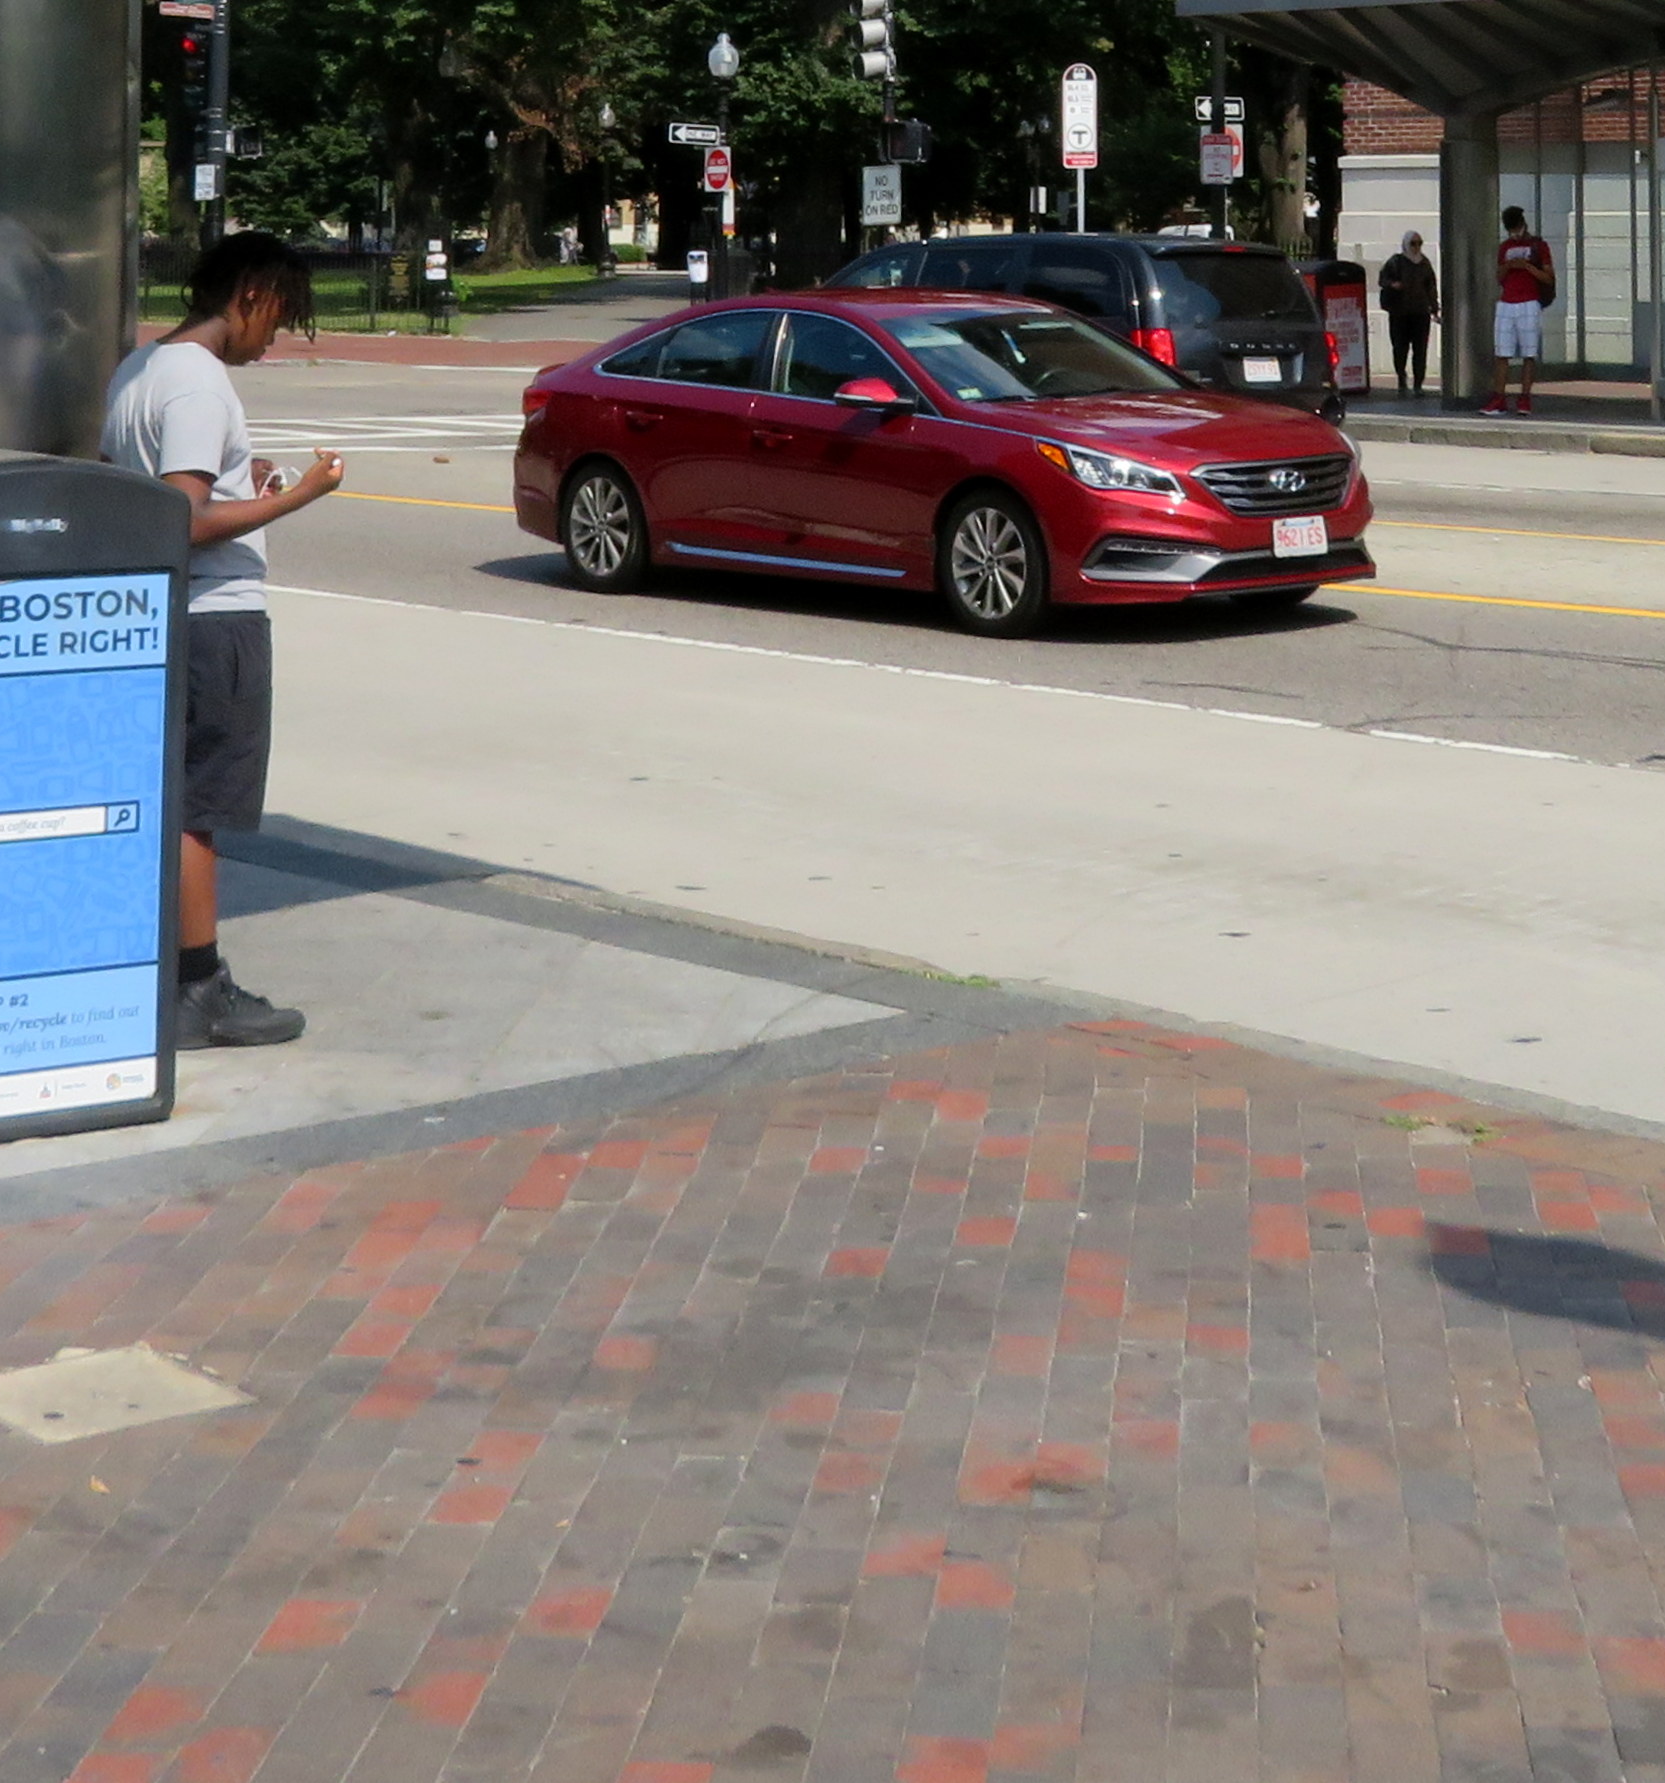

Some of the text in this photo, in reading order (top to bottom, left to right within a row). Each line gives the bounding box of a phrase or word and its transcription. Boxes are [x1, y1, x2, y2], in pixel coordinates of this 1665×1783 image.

[875, 175, 887, 186] NO
[870, 190, 894, 201] TURN
[866, 204, 898, 216] ON RED
[1307, 526, 1324, 546] ES
[59, 627, 159, 655] RIGHT!
[7, 819, 38, 834] coffee
[40, 816, 67, 831] cup?
[9, 994, 29, 1008] #2
[70, 1012, 85, 1024] to
[87, 1006, 114, 1025] find
[118, 1005, 140, 1018] out
[4, 1037, 36, 1059] right
[41, 1038, 56, 1051] in
[59, 1033, 107, 1049] Boston.
